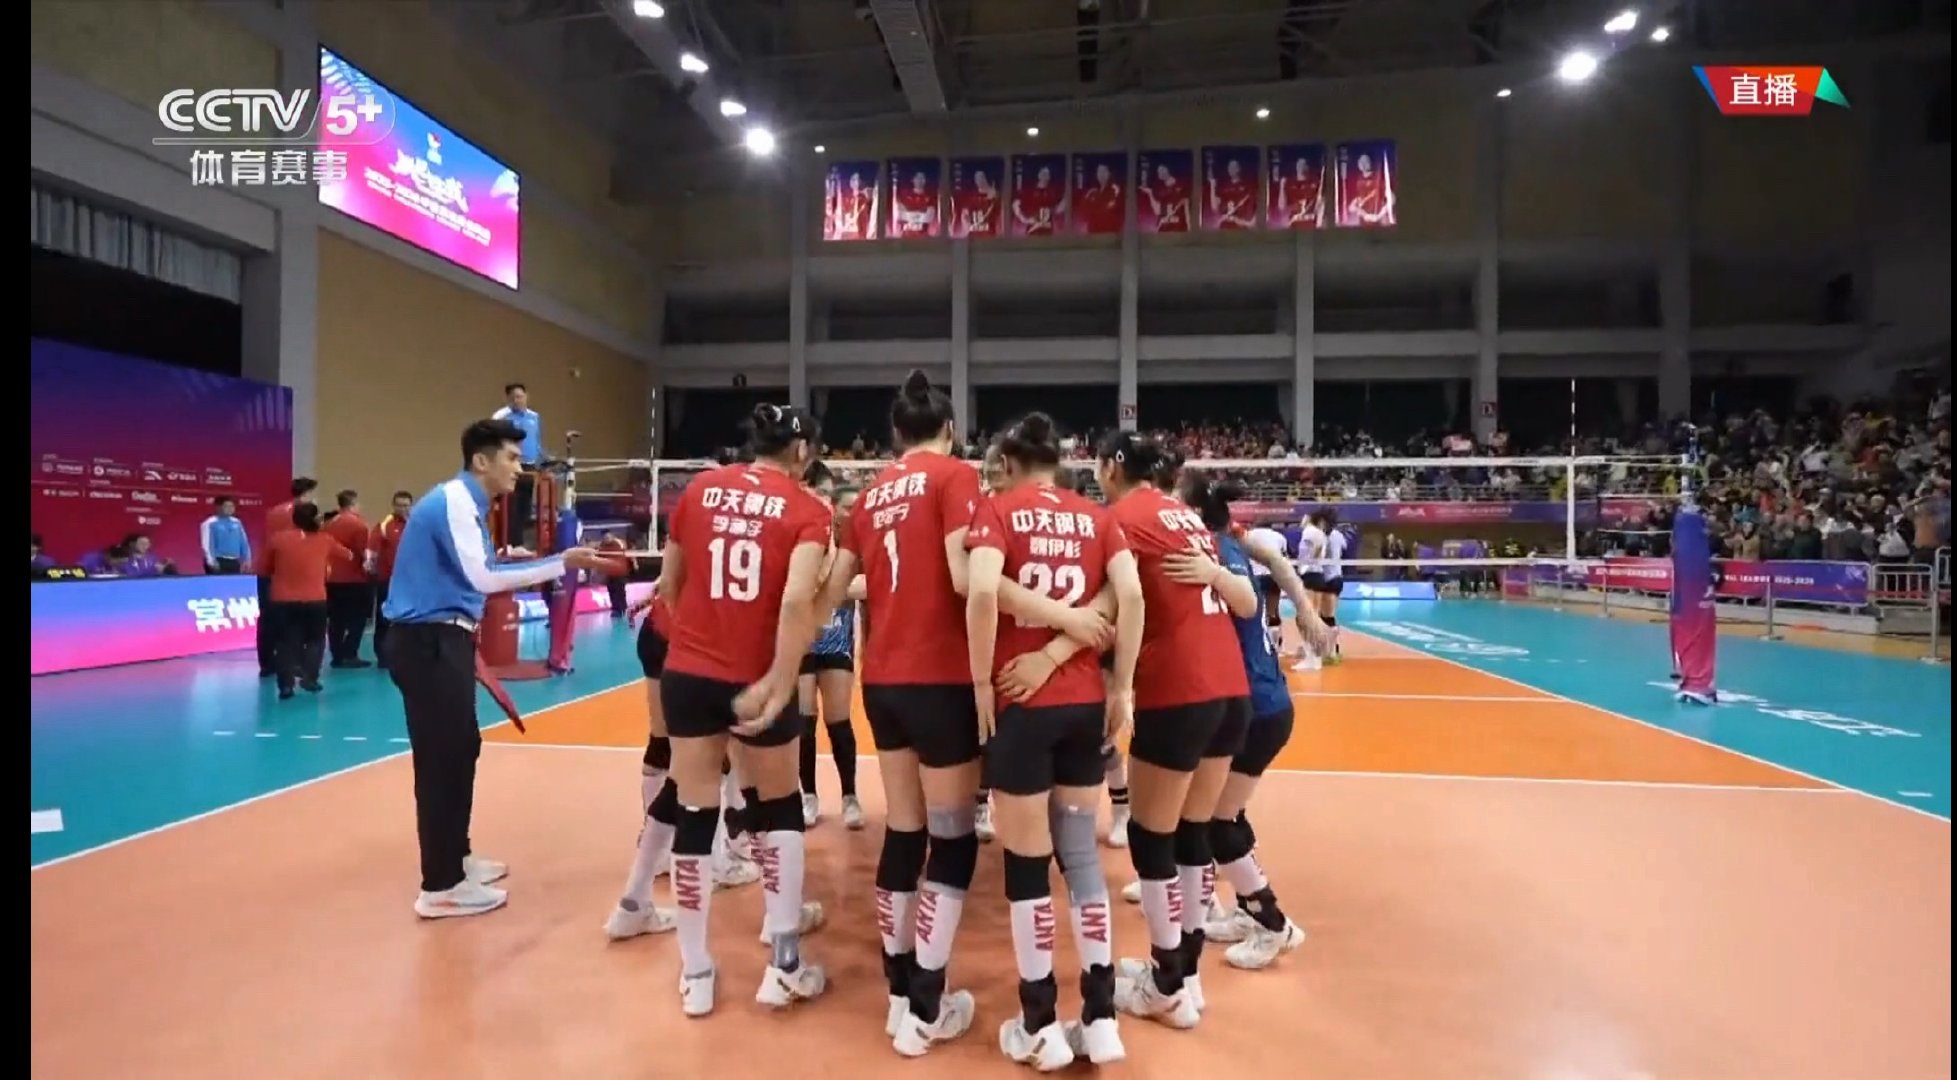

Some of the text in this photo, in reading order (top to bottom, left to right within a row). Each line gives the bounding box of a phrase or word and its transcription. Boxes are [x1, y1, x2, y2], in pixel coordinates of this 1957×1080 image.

[702, 487, 786, 519] 中天钢铁
[864, 472, 927, 509] 中天钢铁
[1011, 507, 1095, 538] 中天钢铁
[708, 537, 762, 602] 19
[884, 529, 899, 593] 1
[1018, 562, 1086, 627] 22
[675, 859, 701, 911] ANTA
[1034, 902, 1055, 951] ANTA
[1081, 903, 1107, 943] ANT
